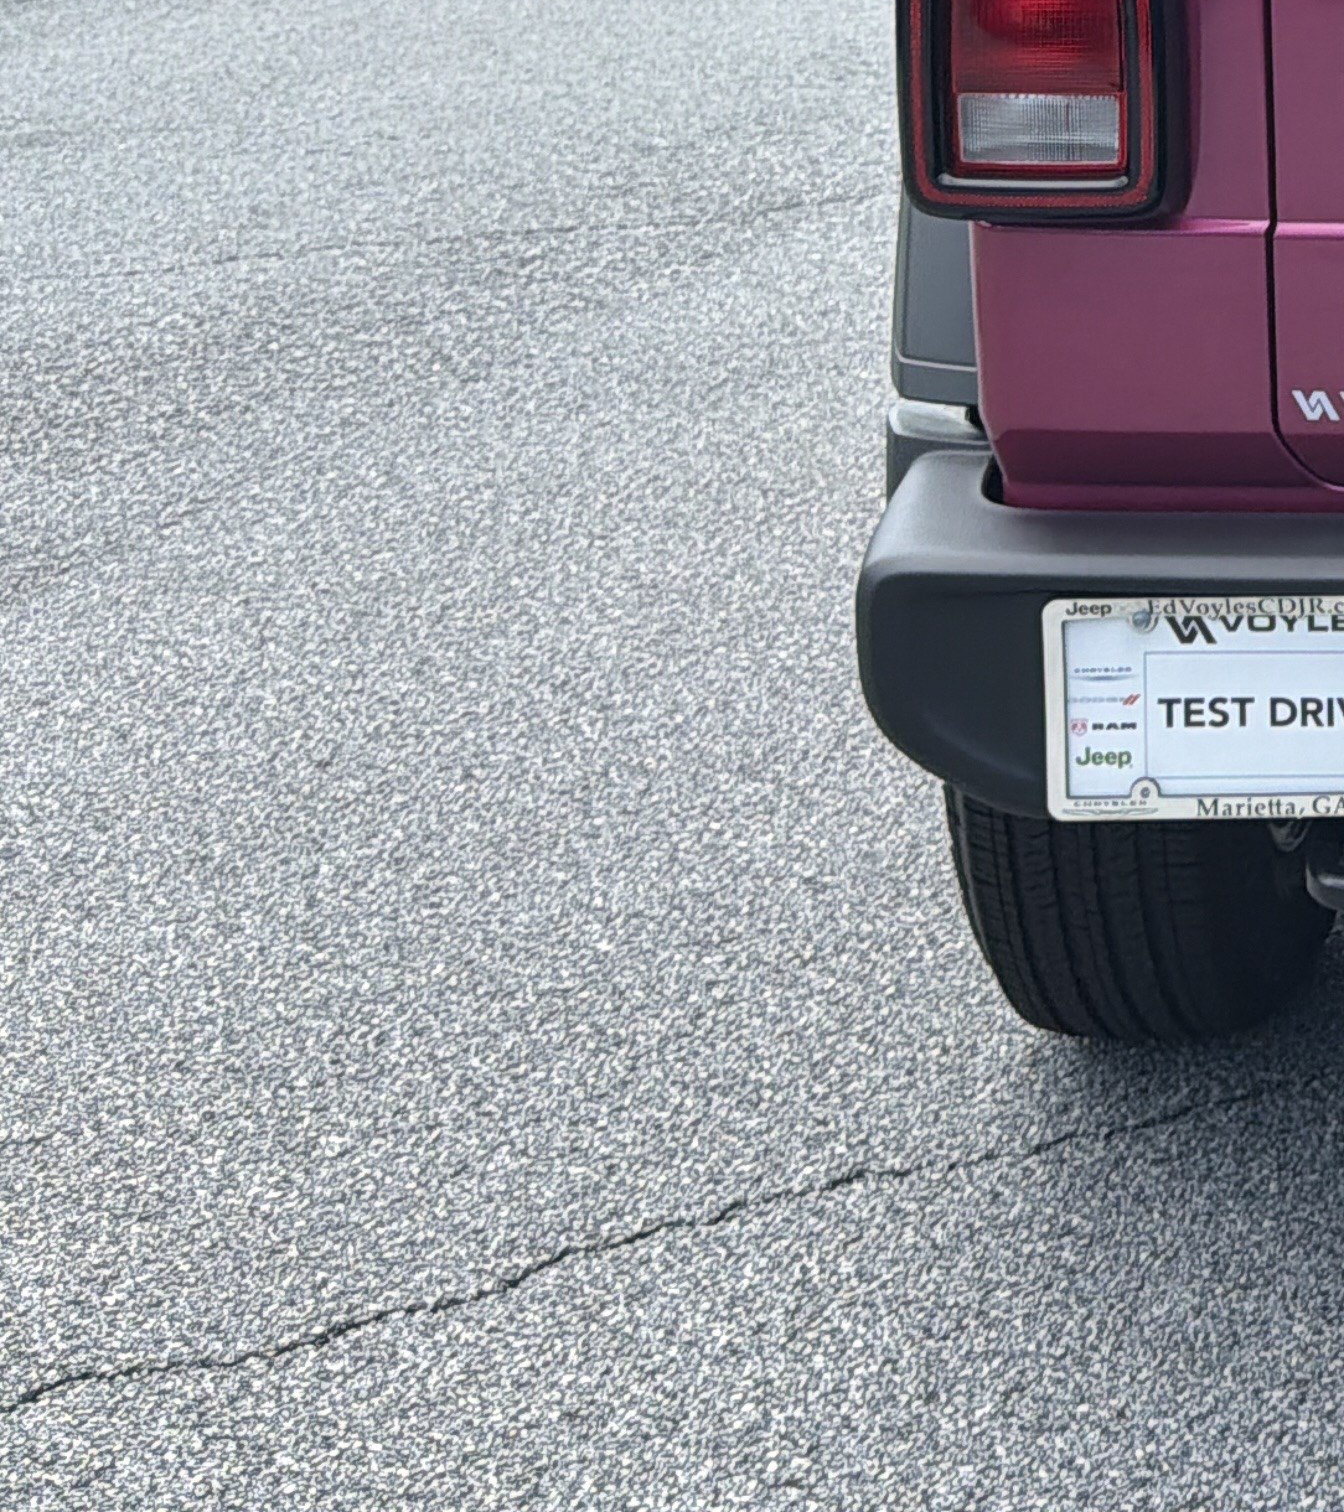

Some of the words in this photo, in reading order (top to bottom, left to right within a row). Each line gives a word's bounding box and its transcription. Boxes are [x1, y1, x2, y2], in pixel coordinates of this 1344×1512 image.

[1065, 601, 1112, 618] Jeep
[1157, 696, 1255, 728] TEST
[1075, 746, 1132, 769] Jeep
[1196, 797, 1305, 817] Marietta,
